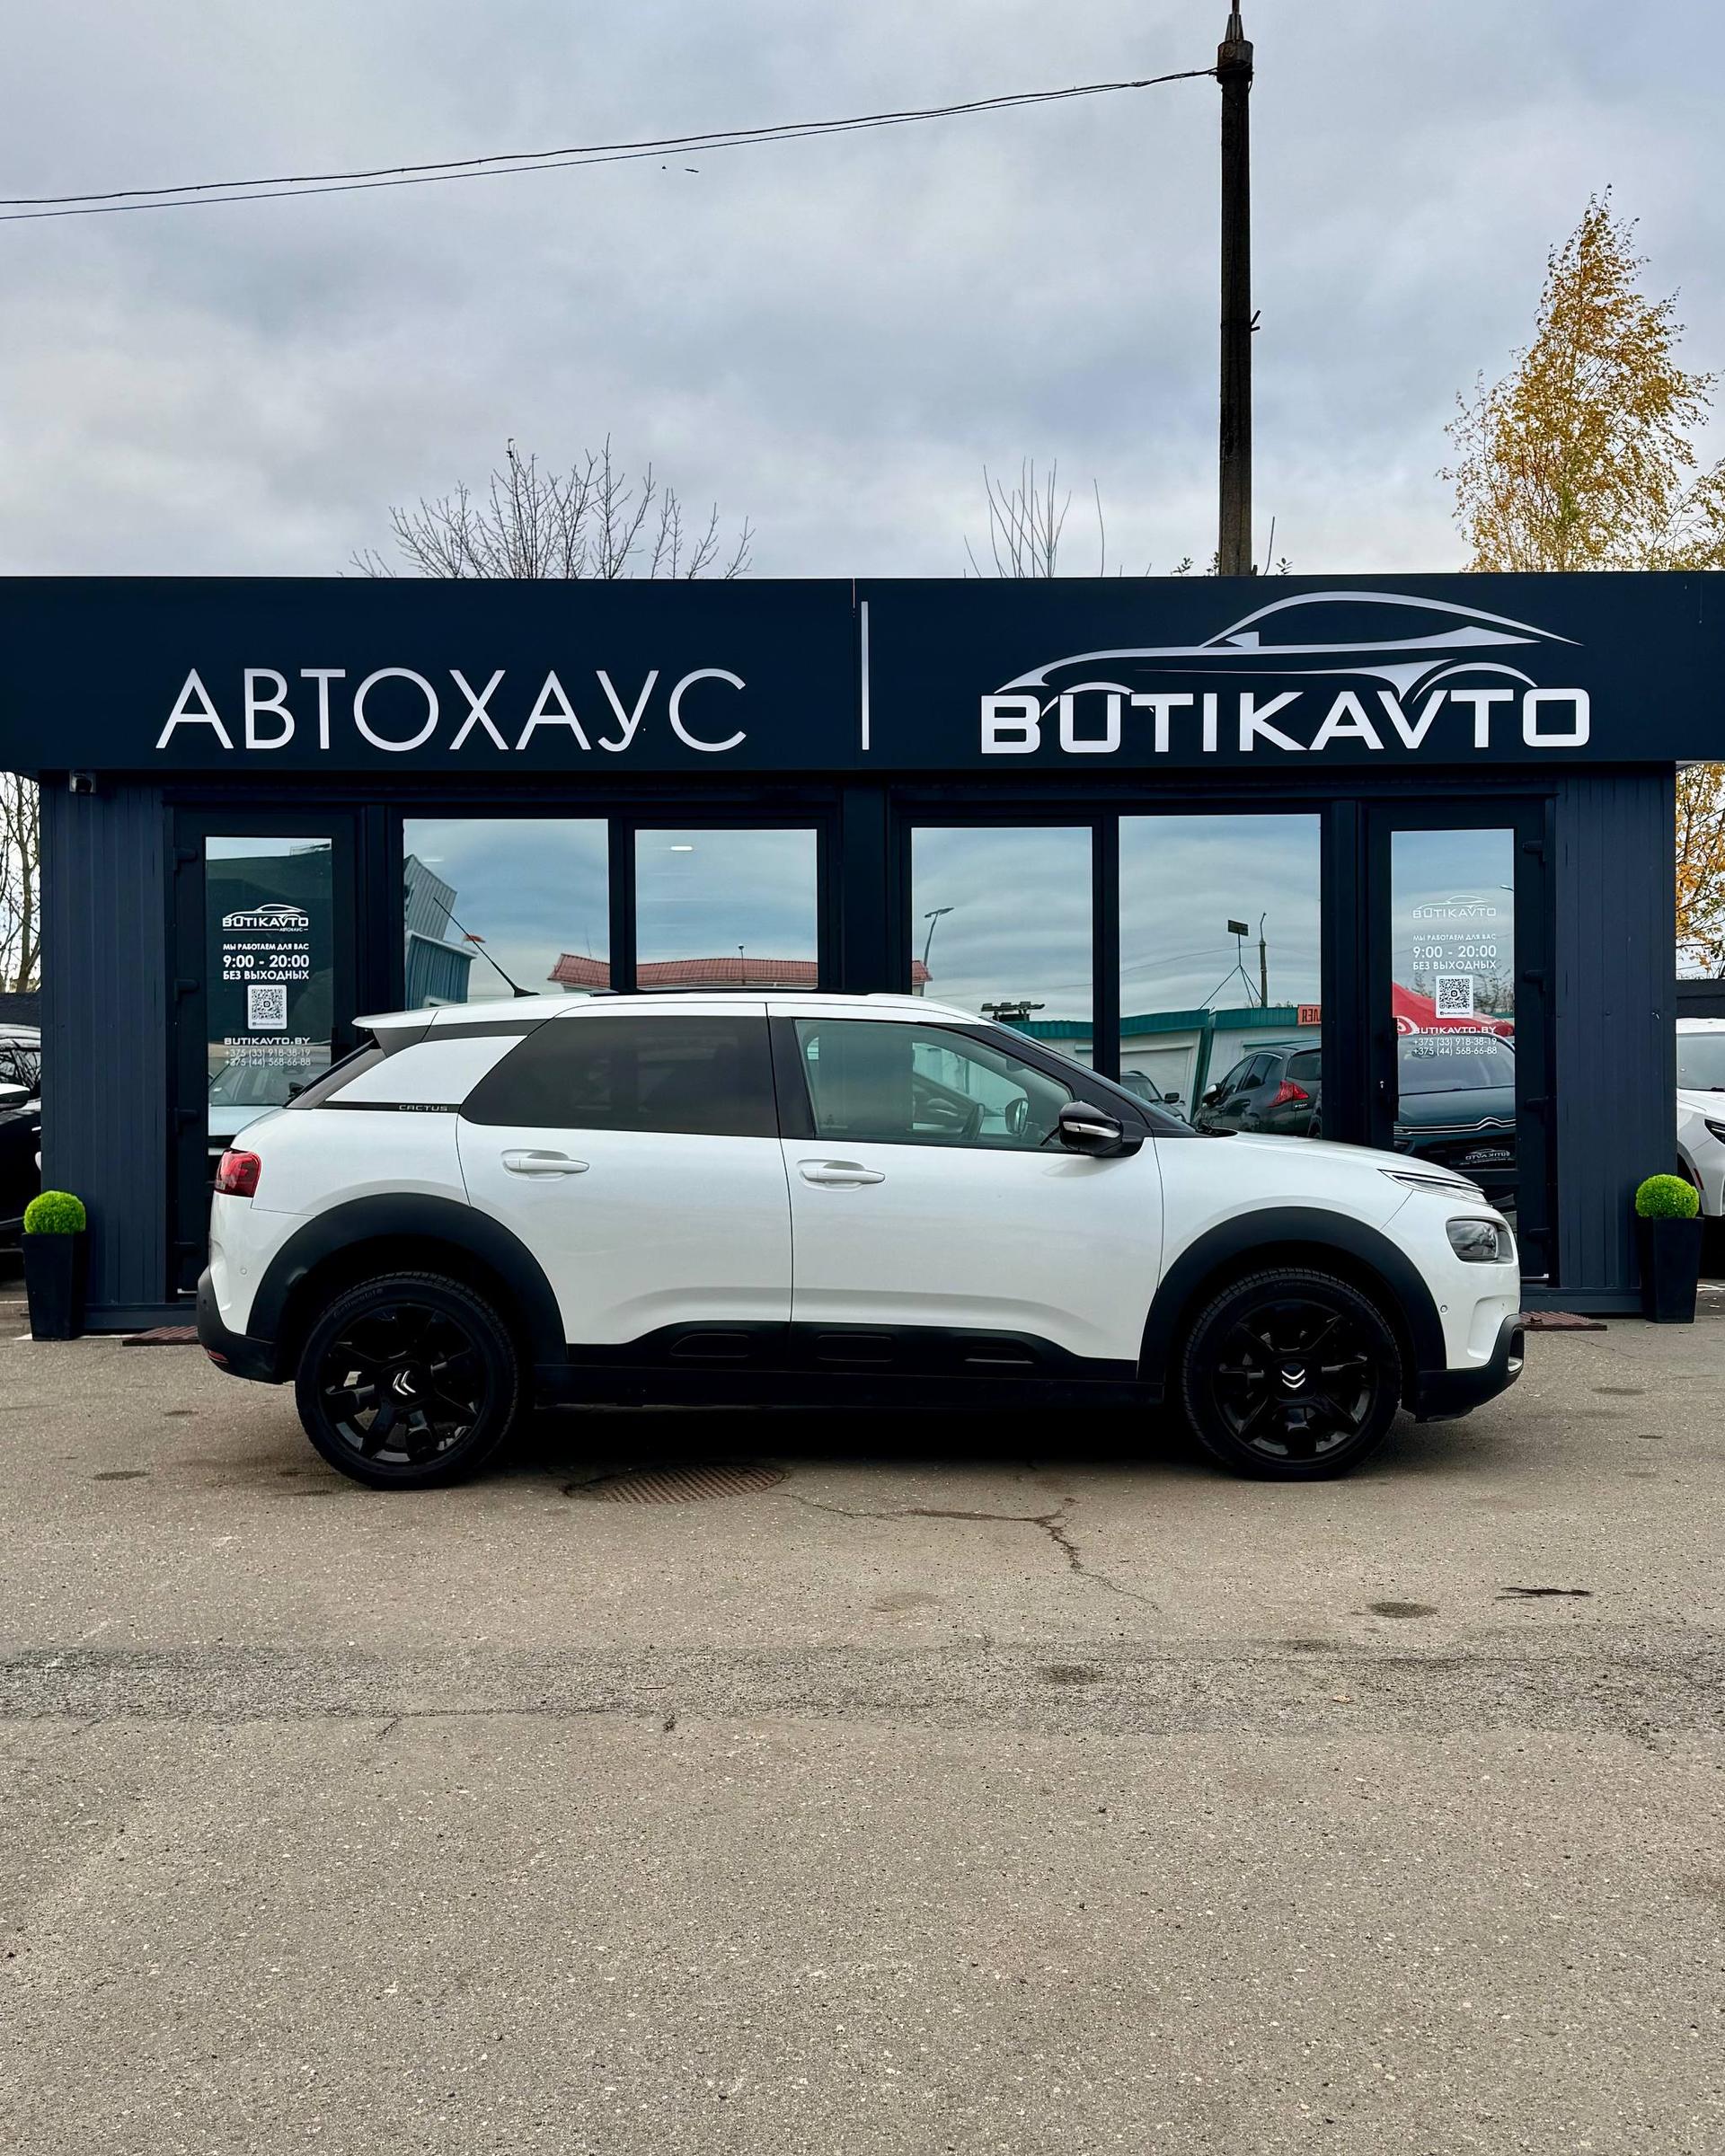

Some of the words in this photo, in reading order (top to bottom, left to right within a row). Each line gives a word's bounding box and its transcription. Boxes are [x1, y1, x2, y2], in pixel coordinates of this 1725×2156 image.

[155, 667, 747, 753] АВТОХАУС
[980, 688, 1590, 755] BUTIKAVTO
[1412, 907, 1496, 919] BUTIKAVTO
[222, 916, 309, 927] BUTIKAVTO
[1413, 945, 1443, 959] 9:00
[1457, 945, 1497, 958] 20:00
[223, 954, 254, 968] 9:00
[269, 954, 310, 968] 20:00
[1413, 961, 1430, 970] БЕЗ
[1433, 960, 1497, 970] ВЫХОДНЫХ
[223, 970, 241, 980] БЕЗ
[243, 970, 310, 981] ВЫХОДНЫХ
[1413, 1026, 1497, 1034] BUTIKAVTO.BY
[224, 1037, 311, 1045] BUTIKAVTO.BY
[1413, 1038, 1434, 1046] +375
[1437, 1038, 1453, 1047] (33)
[1455, 1038, 1498, 1046] 918-38-19
[226, 1048, 246, 1057] +375
[249, 1048, 265, 1058] (33)
[269, 1048, 311, 1057] 918-38-19
[1413, 1047, 1434, 1055] +375
[1437, 1047, 1453, 1056] (44)
[1455, 1047, 1498, 1055] 568-66-88
[226, 1057, 246, 1066] +375
[249, 1057, 265, 1068] (44)
[269, 1057, 311, 1066] 568-66-88
[398, 1104, 448, 1112] CACTUS
